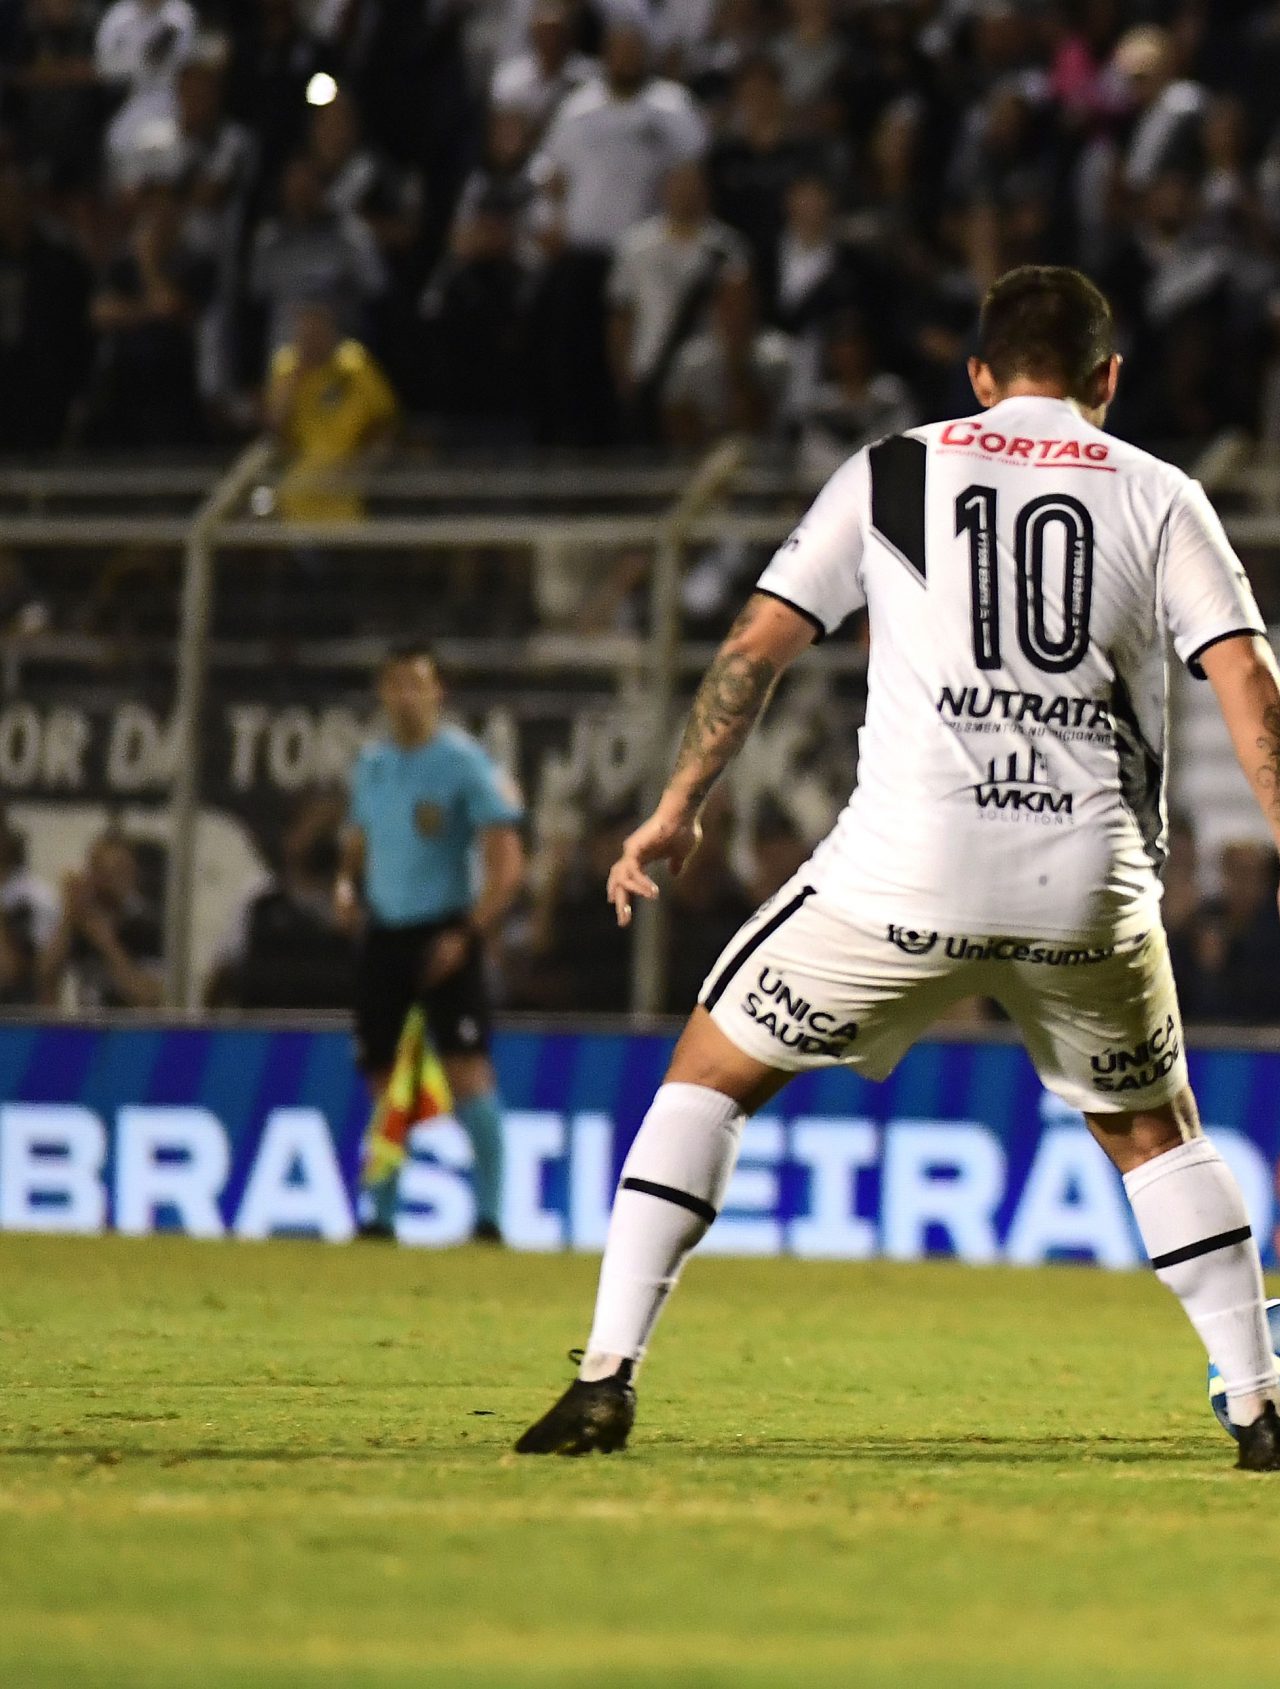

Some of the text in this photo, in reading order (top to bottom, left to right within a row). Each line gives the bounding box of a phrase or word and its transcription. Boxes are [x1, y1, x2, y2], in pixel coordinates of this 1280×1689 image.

[941, 422, 1109, 462] CORTAG
[955, 484, 1094, 674] 10
[937, 686, 1115, 730] NUTRATA
[973, 785, 1073, 814] WKM
[975, 809, 1075, 827] SOLUTIONS
[1091, 1014, 1176, 1075] ÚNICA
